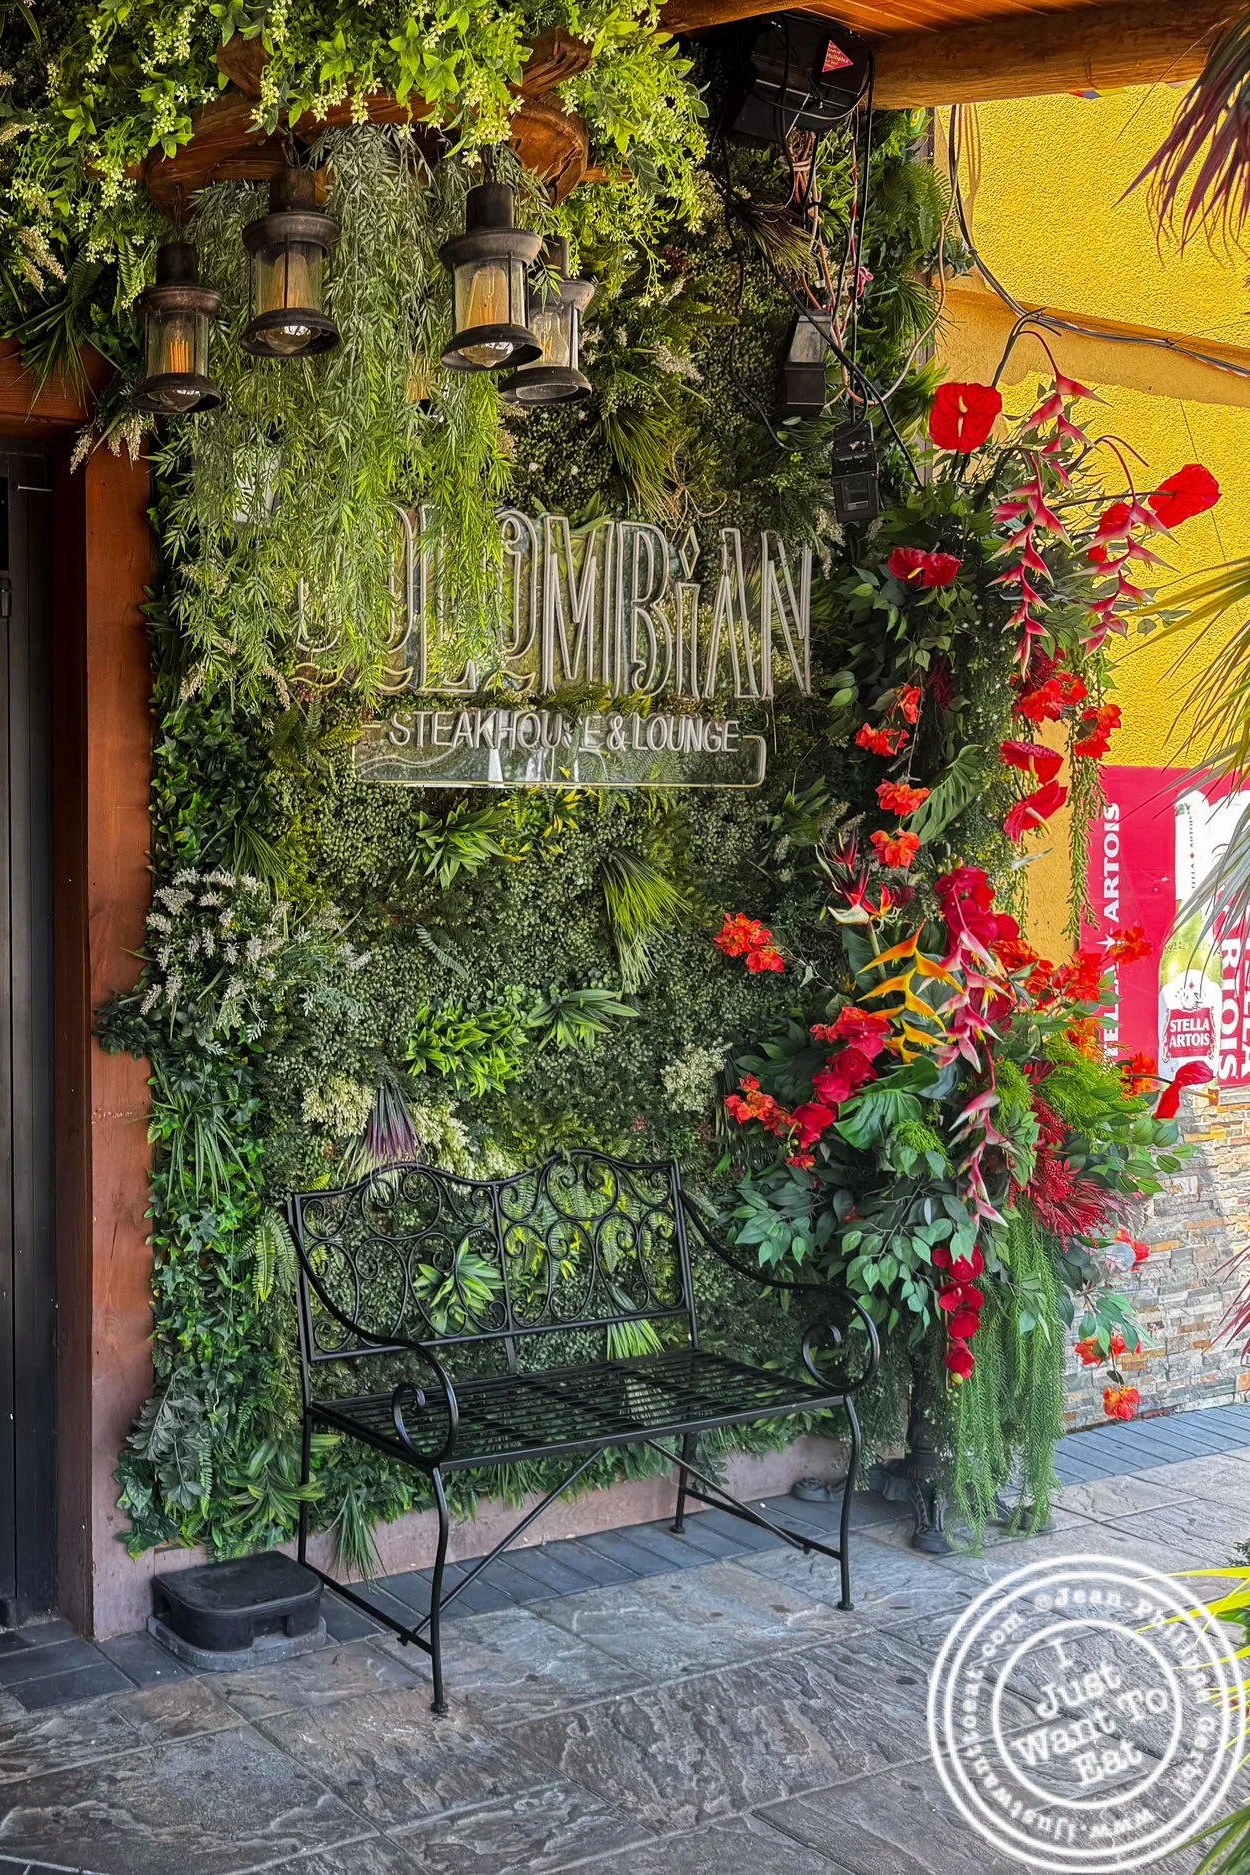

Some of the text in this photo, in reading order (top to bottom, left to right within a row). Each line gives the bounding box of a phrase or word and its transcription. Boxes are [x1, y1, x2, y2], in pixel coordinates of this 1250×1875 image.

[607, 715, 628, 751] &
[631, 713, 740, 753] LOUNGE
[1103, 802, 1120, 923] ARTOIS
[1218, 905, 1240, 1080] RTOIS
[1169, 1033, 1210, 1048] ARTOIS
[1170, 1018, 1210, 1032] STELLA
